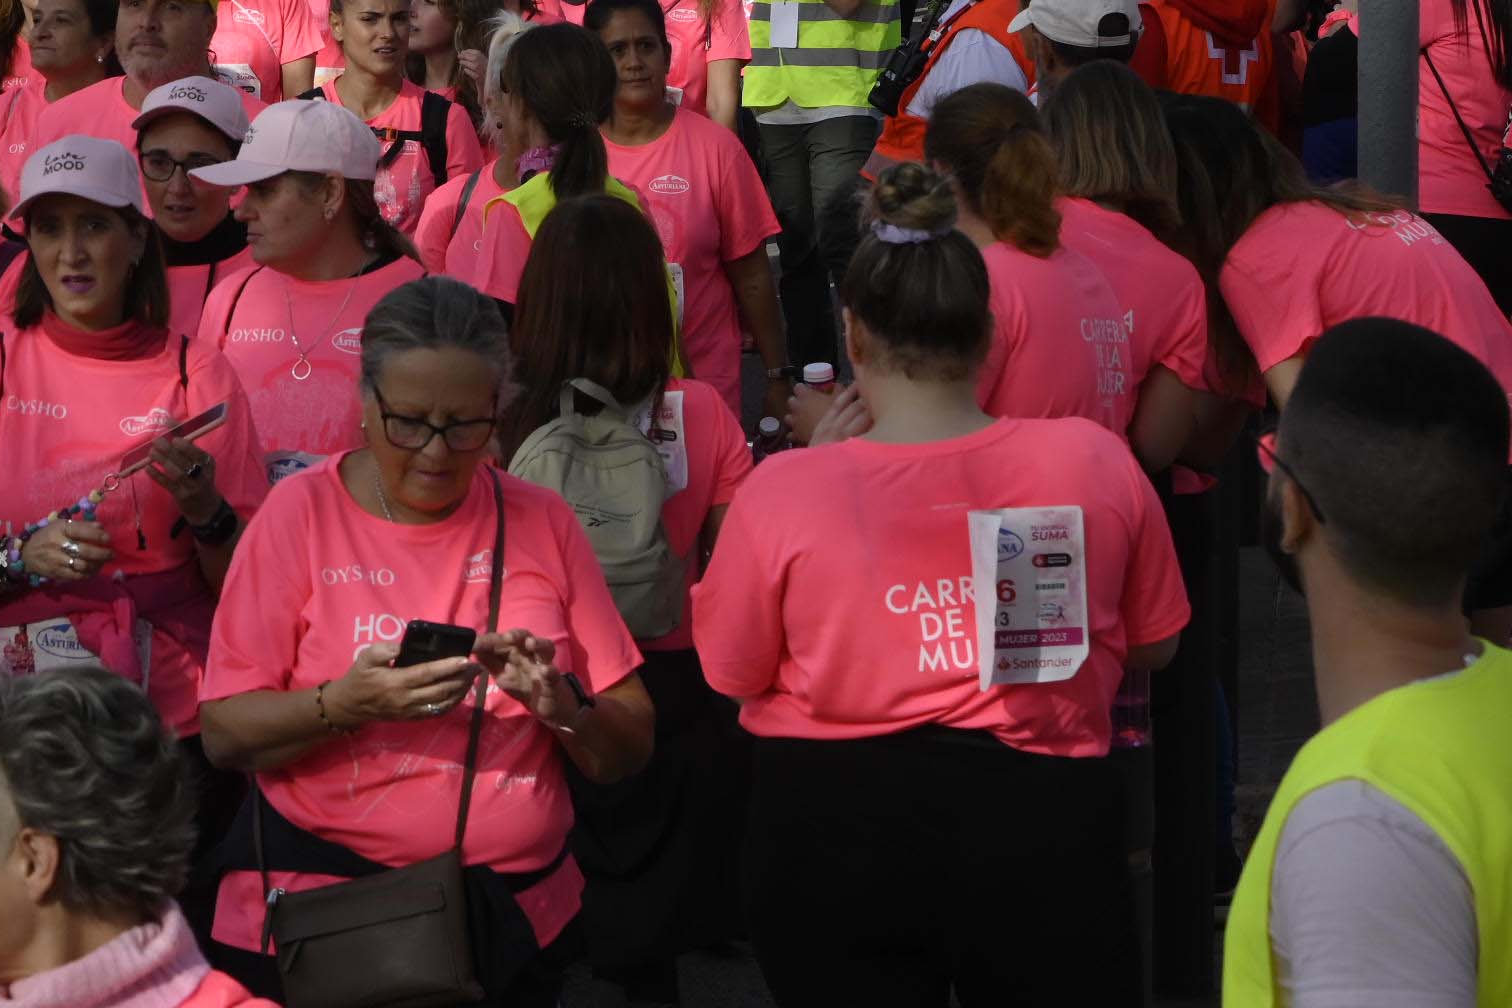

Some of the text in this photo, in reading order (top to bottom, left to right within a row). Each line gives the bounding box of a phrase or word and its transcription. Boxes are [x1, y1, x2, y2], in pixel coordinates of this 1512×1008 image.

[43, 160, 85, 175] MOOD
[231, 327, 285, 343] OYSHO
[6, 395, 68, 419] OYSHO
[1031, 530, 1069, 541] SUMA
[920, 610, 965, 643] DE
[999, 632, 1068, 644] MUJER 2023
[1012, 657, 1073, 670] Santander
